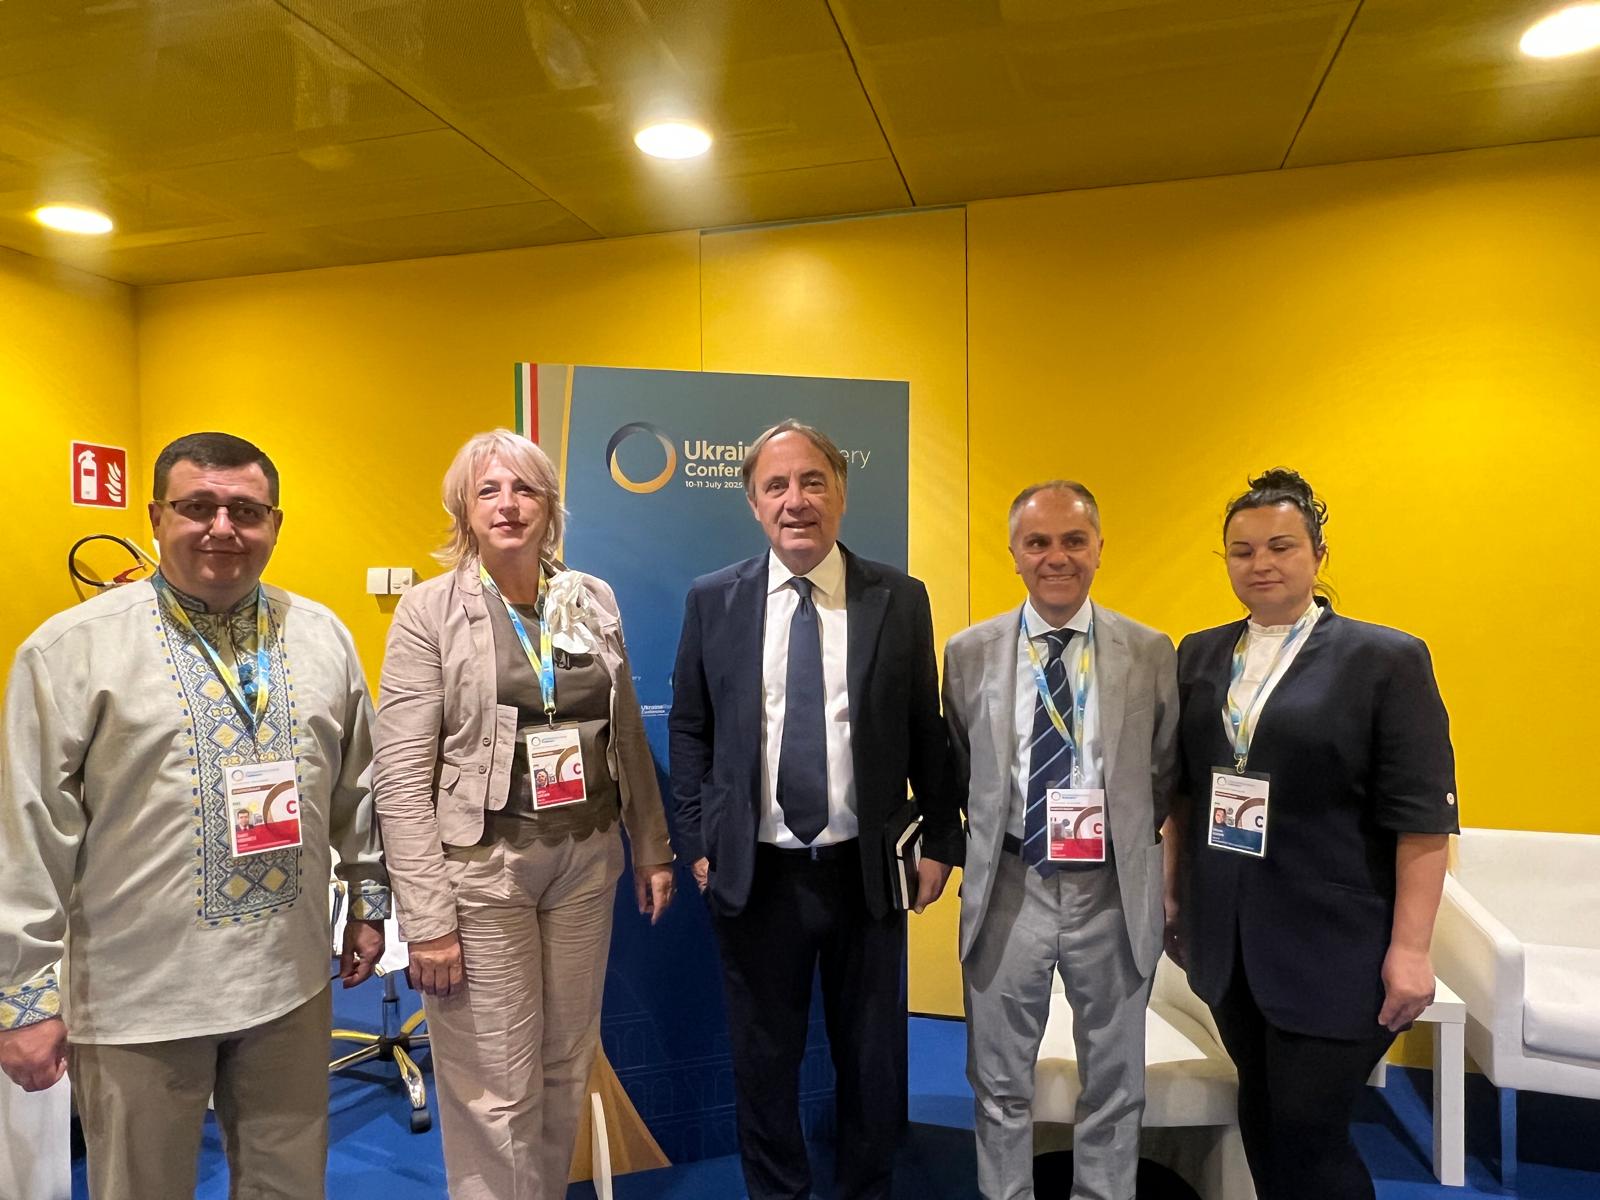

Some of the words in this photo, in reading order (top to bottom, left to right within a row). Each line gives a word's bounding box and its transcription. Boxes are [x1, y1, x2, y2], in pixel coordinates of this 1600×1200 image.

[839, 449, 871, 469] ery
[684, 462, 742, 477] Confer
[685, 480, 703, 488] 10-11
[705, 480, 722, 490] July
[286, 800, 297, 815] C
[1093, 822, 1103, 835] C
[1255, 815, 1264, 828] C
